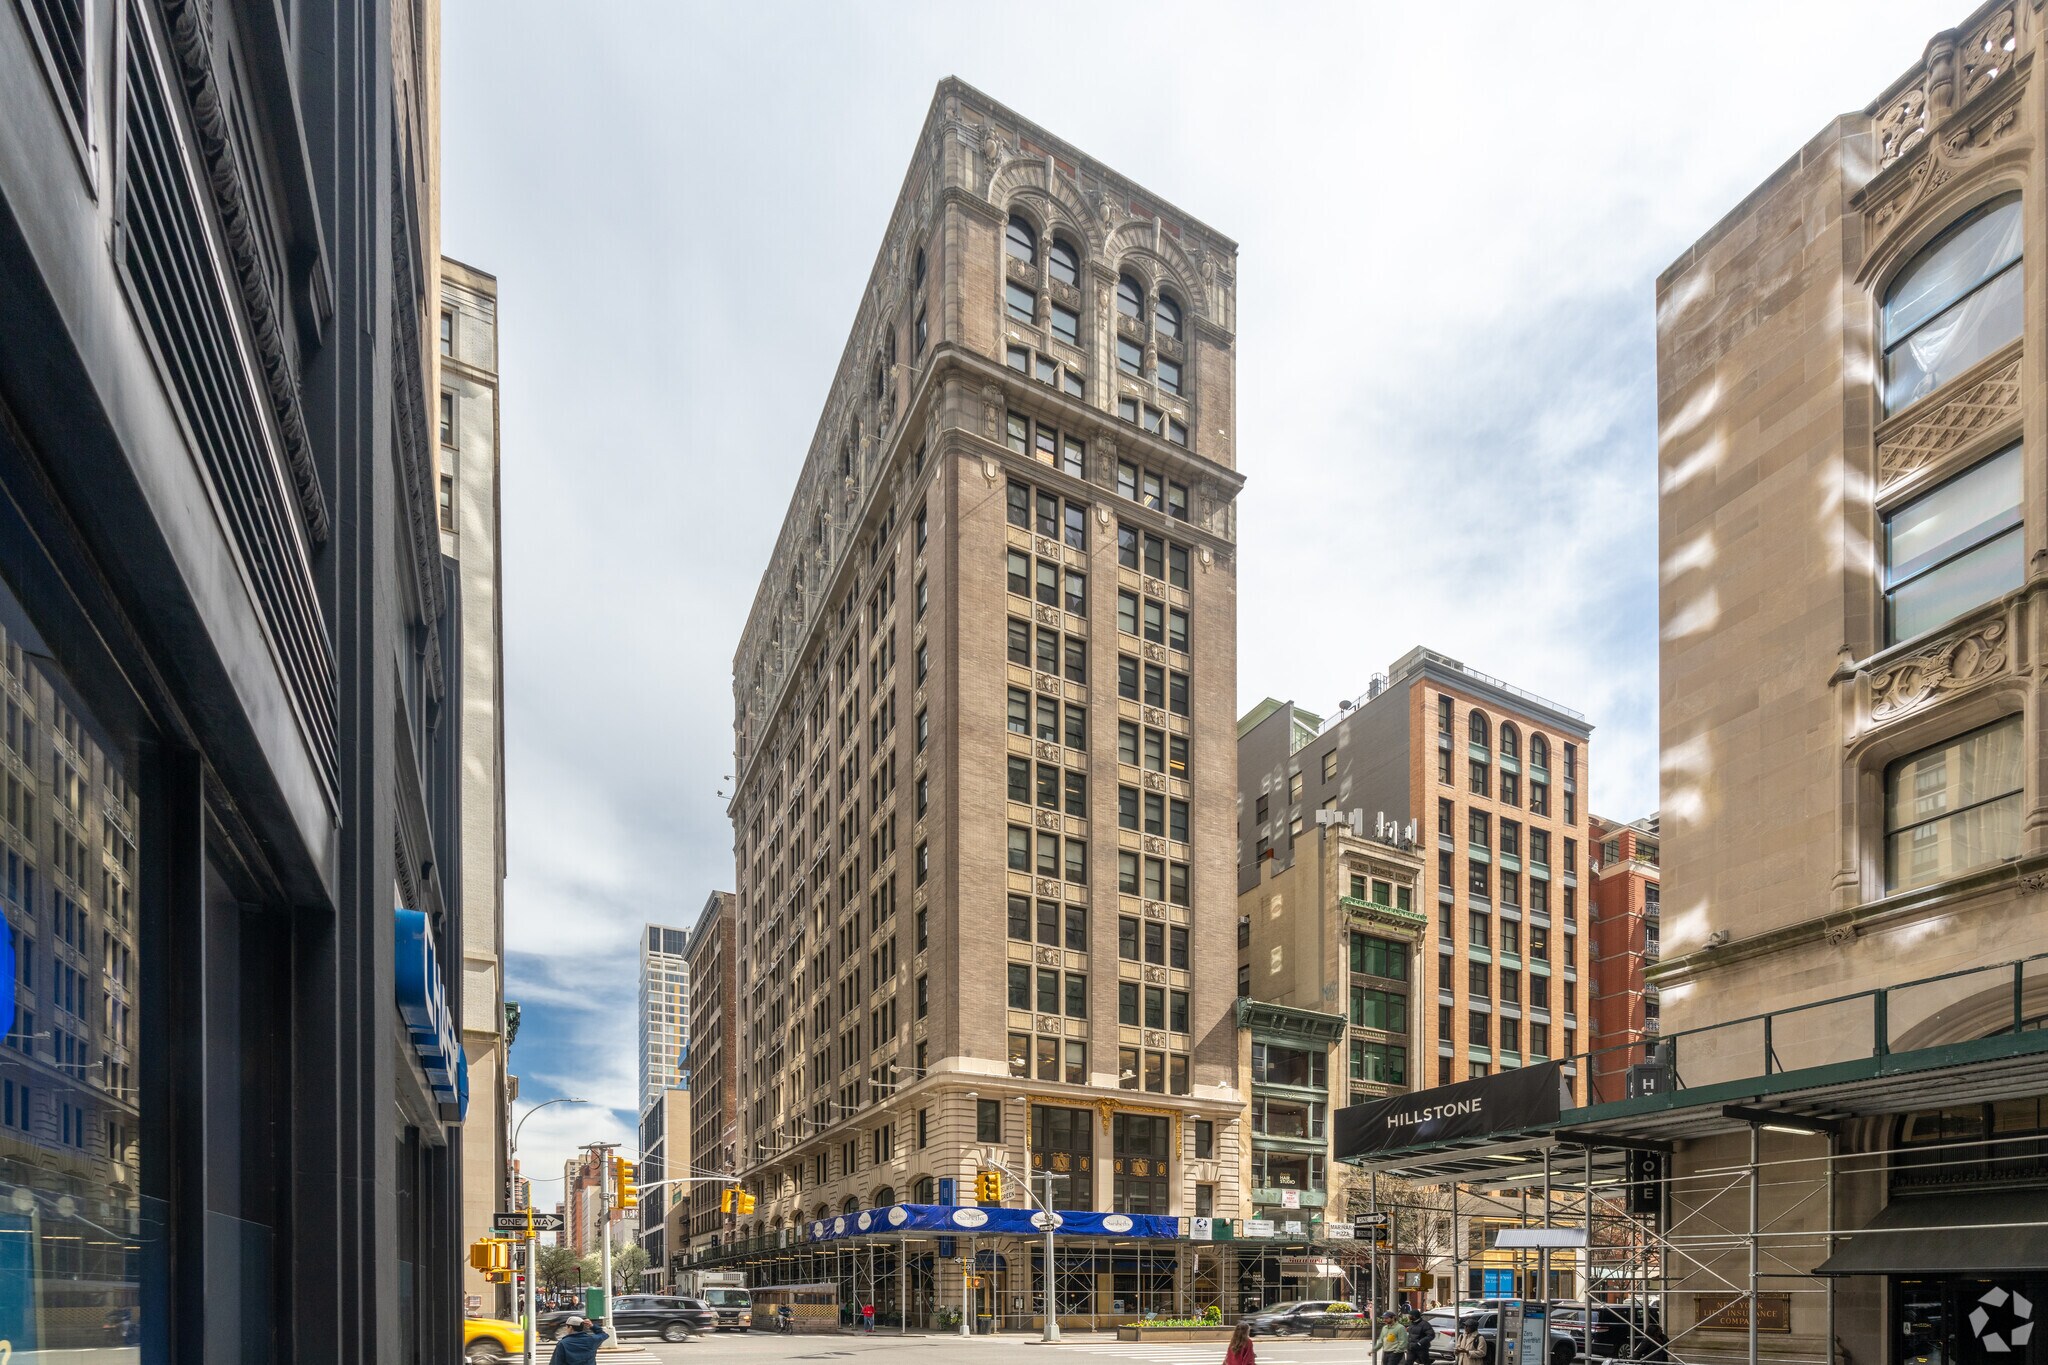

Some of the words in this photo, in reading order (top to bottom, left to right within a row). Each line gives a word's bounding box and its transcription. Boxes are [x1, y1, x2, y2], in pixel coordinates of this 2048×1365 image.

[1387, 1098, 1482, 1128] HILLSTONE
[500, 1218, 522, 1226] ONE
[1739, 1301, 1763, 1310] YOK
[1727, 1309, 1777, 1318] INSUANCE
[1720, 1317, 1762, 1326] COMPAY
